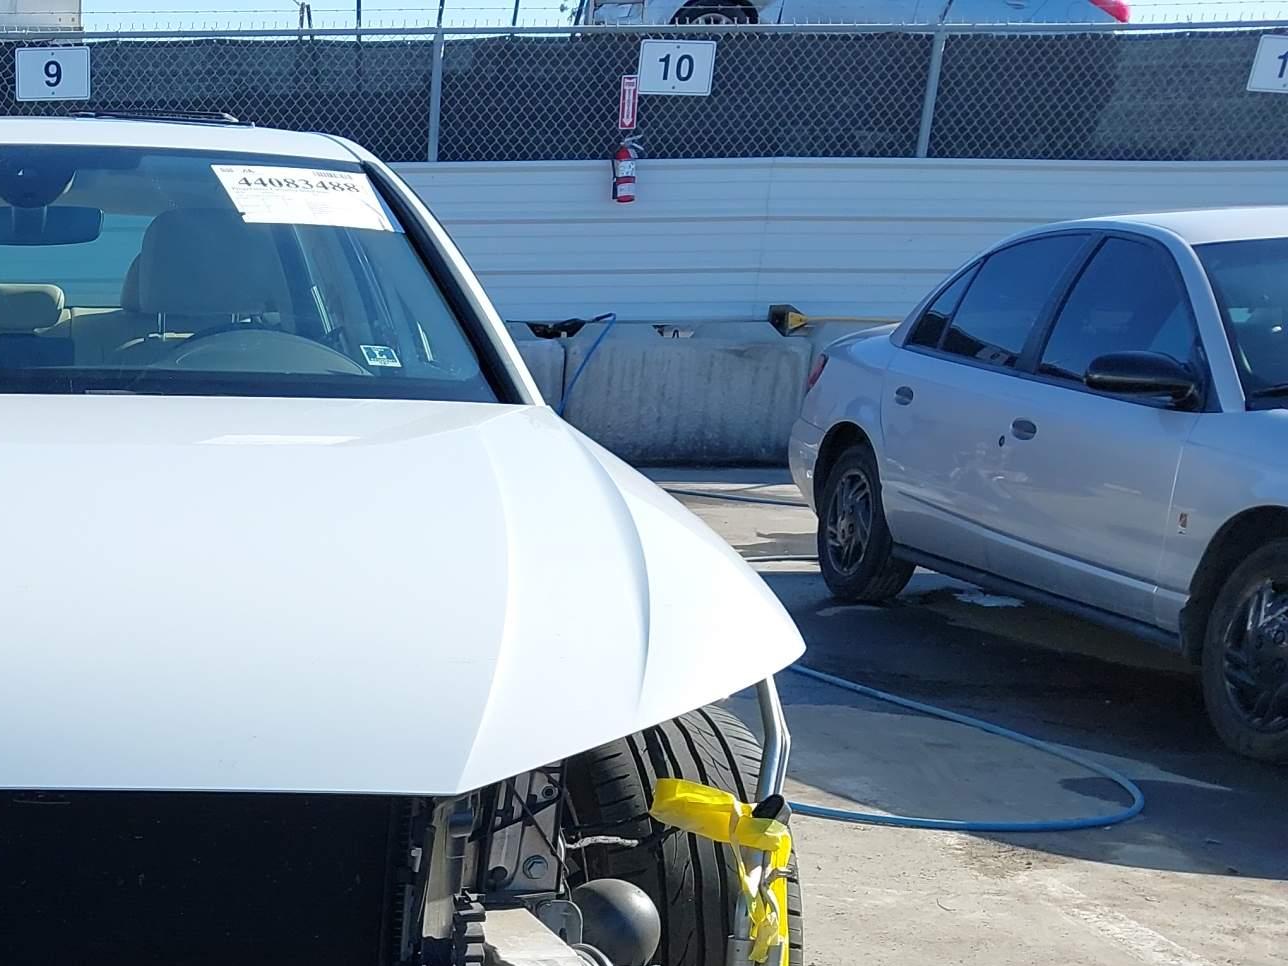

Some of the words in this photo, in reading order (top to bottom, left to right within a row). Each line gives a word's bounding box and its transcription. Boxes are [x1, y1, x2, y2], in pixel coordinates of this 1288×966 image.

[44, 60, 62, 87] 9
[658, 54, 694, 82] 10
[238, 176, 360, 193] 44083488
